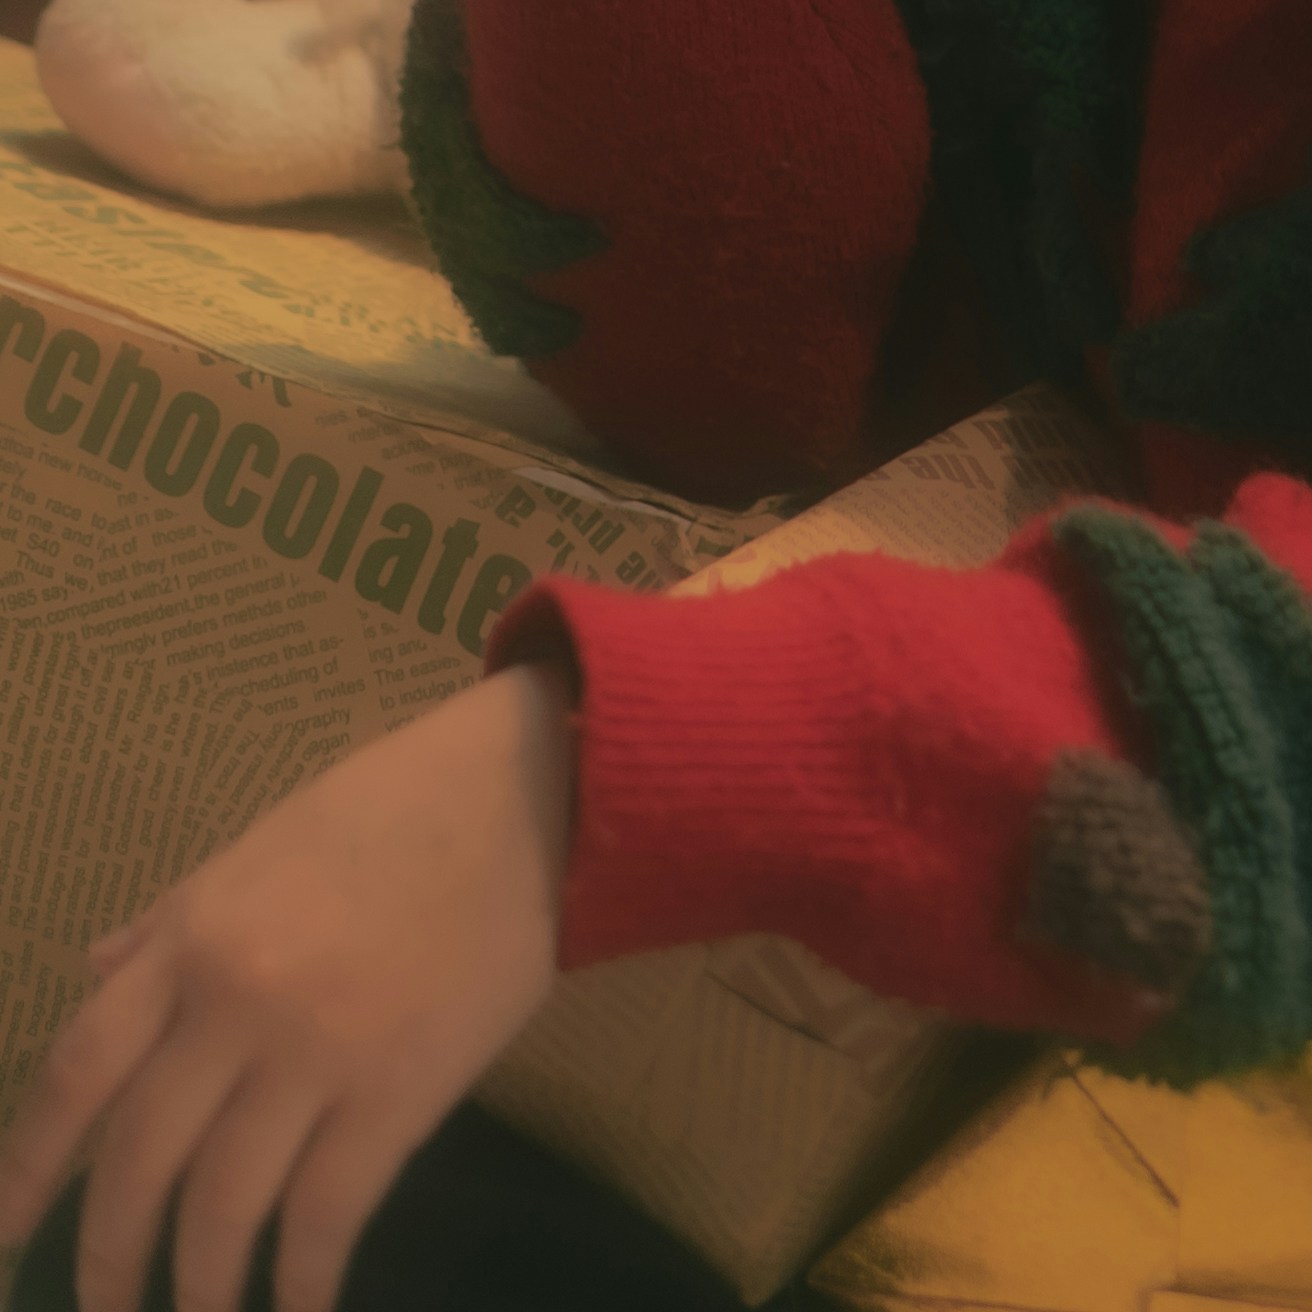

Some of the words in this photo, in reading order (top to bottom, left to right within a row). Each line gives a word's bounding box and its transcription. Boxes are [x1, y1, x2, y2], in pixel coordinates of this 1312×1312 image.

[4, 503, 26, 524] to
[59, 521, 95, 549] and
[43, 496, 84, 523] race
[88, 511, 108, 531] to
[133, 509, 151, 527] in
[119, 534, 141, 557] of
[150, 520, 198, 548] those
[13, 549, 57, 579] Thus
[95, 562, 129, 588] that
[129, 551, 169, 582] they
[168, 542, 209, 568] read
[184, 556, 251, 590] percent
[222, 570, 288, 607] general
[158, 611, 221, 648] prefers
[164, 635, 227, 668] making
[281, 638, 316, 661] that
[320, 655, 340, 676] of
[311, 675, 367, 702] invites
[373, 666, 405, 686] The
[73, 689, 88, 701] it
[88, 683, 110, 716] civil
[228, 696, 256, 725] the
[378, 692, 395, 711] to
[397, 677, 457, 704] indulge
[3, 690, 31, 745] military
[62, 702, 87, 745] laugh
[101, 685, 129, 742] makers
[162, 709, 182, 736] the
[16, 723, 40, 769] defies
[41, 722, 59, 745] for
[77, 720, 99, 765] about
[140, 721, 158, 745] his
[159, 738, 174, 752] is
[174, 709, 206, 760] where
[231, 726, 260, 758] The
[59, 746, 73, 762] to
[132, 750, 150, 773] for
[14, 771, 28, 782] it
[27, 747, 56, 809] grounds
[54, 764, 69, 779] is
[145, 758, 169, 802] cheer
[209, 754, 244, 794] track
[223, 752, 270, 807] instead
[7, 783, 26, 813] that
[102, 761, 127, 823] whether
[201, 789, 220, 808] is
[38, 780, 67, 849] response
[56, 770, 87, 852] wisecracks
[111, 774, 147, 856] Gorbachev
[134, 808, 160, 848] good
[215, 803, 236, 826] he
[13, 808, 42, 873] provides
[74, 836, 92, 859] for
[95, 823, 114, 853] and
[164, 831, 191, 887] matters
[178, 803, 196, 829] are
[55, 852, 69, 868] in
[7, 874, 26, 903] and
[42, 869, 69, 922] indulge
[62, 864, 89, 916] ratings
[82, 858, 107, 916] readers
[99, 861, 125, 914] Mikhail
[20, 904, 40, 933] The
[40, 924, 55, 940] to
[14, 939, 37, 986] invites
[25, 961, 55, 1037] biography
[43, 973, 71, 1034] Reagan
